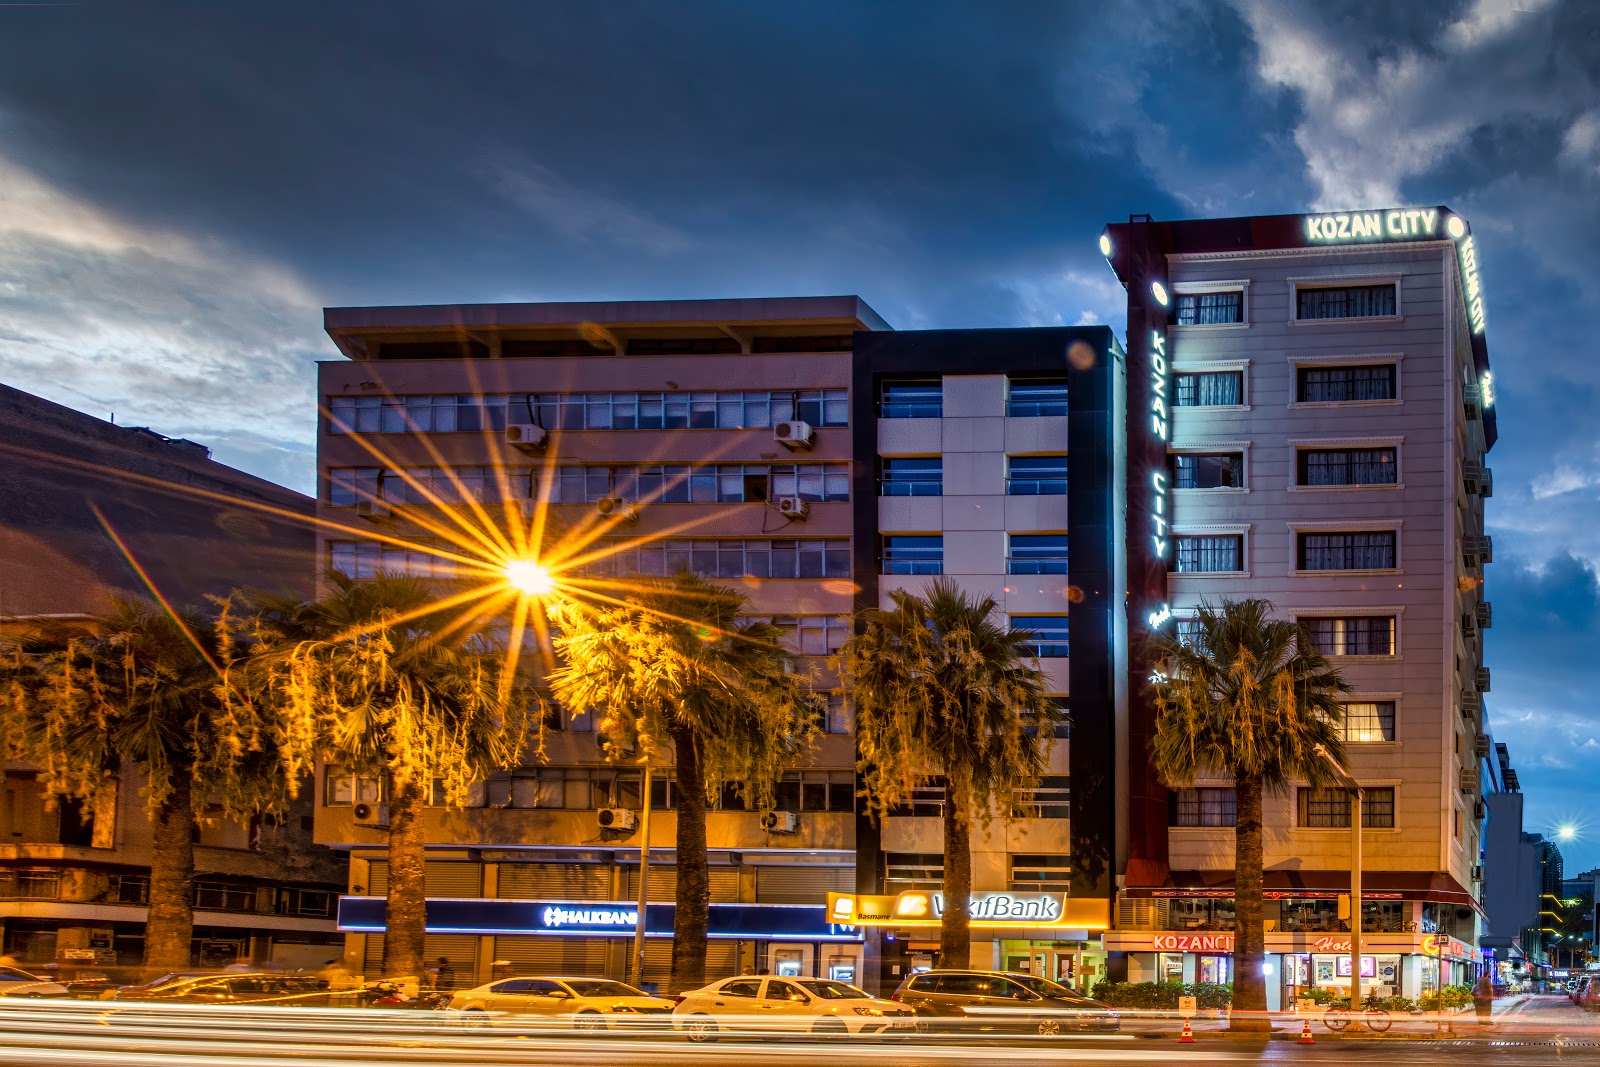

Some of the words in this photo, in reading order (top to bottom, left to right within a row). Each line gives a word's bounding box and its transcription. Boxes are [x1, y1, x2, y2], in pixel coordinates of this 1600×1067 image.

[1307, 213, 1382, 239] KOZAN
[1386, 209, 1436, 235] CITY
[1152, 331, 1166, 440] KOZAN
[1152, 472, 1166, 557] CITY
[934, 895, 1056, 917] VkıfBank
[1314, 936, 1363, 952] Hote
